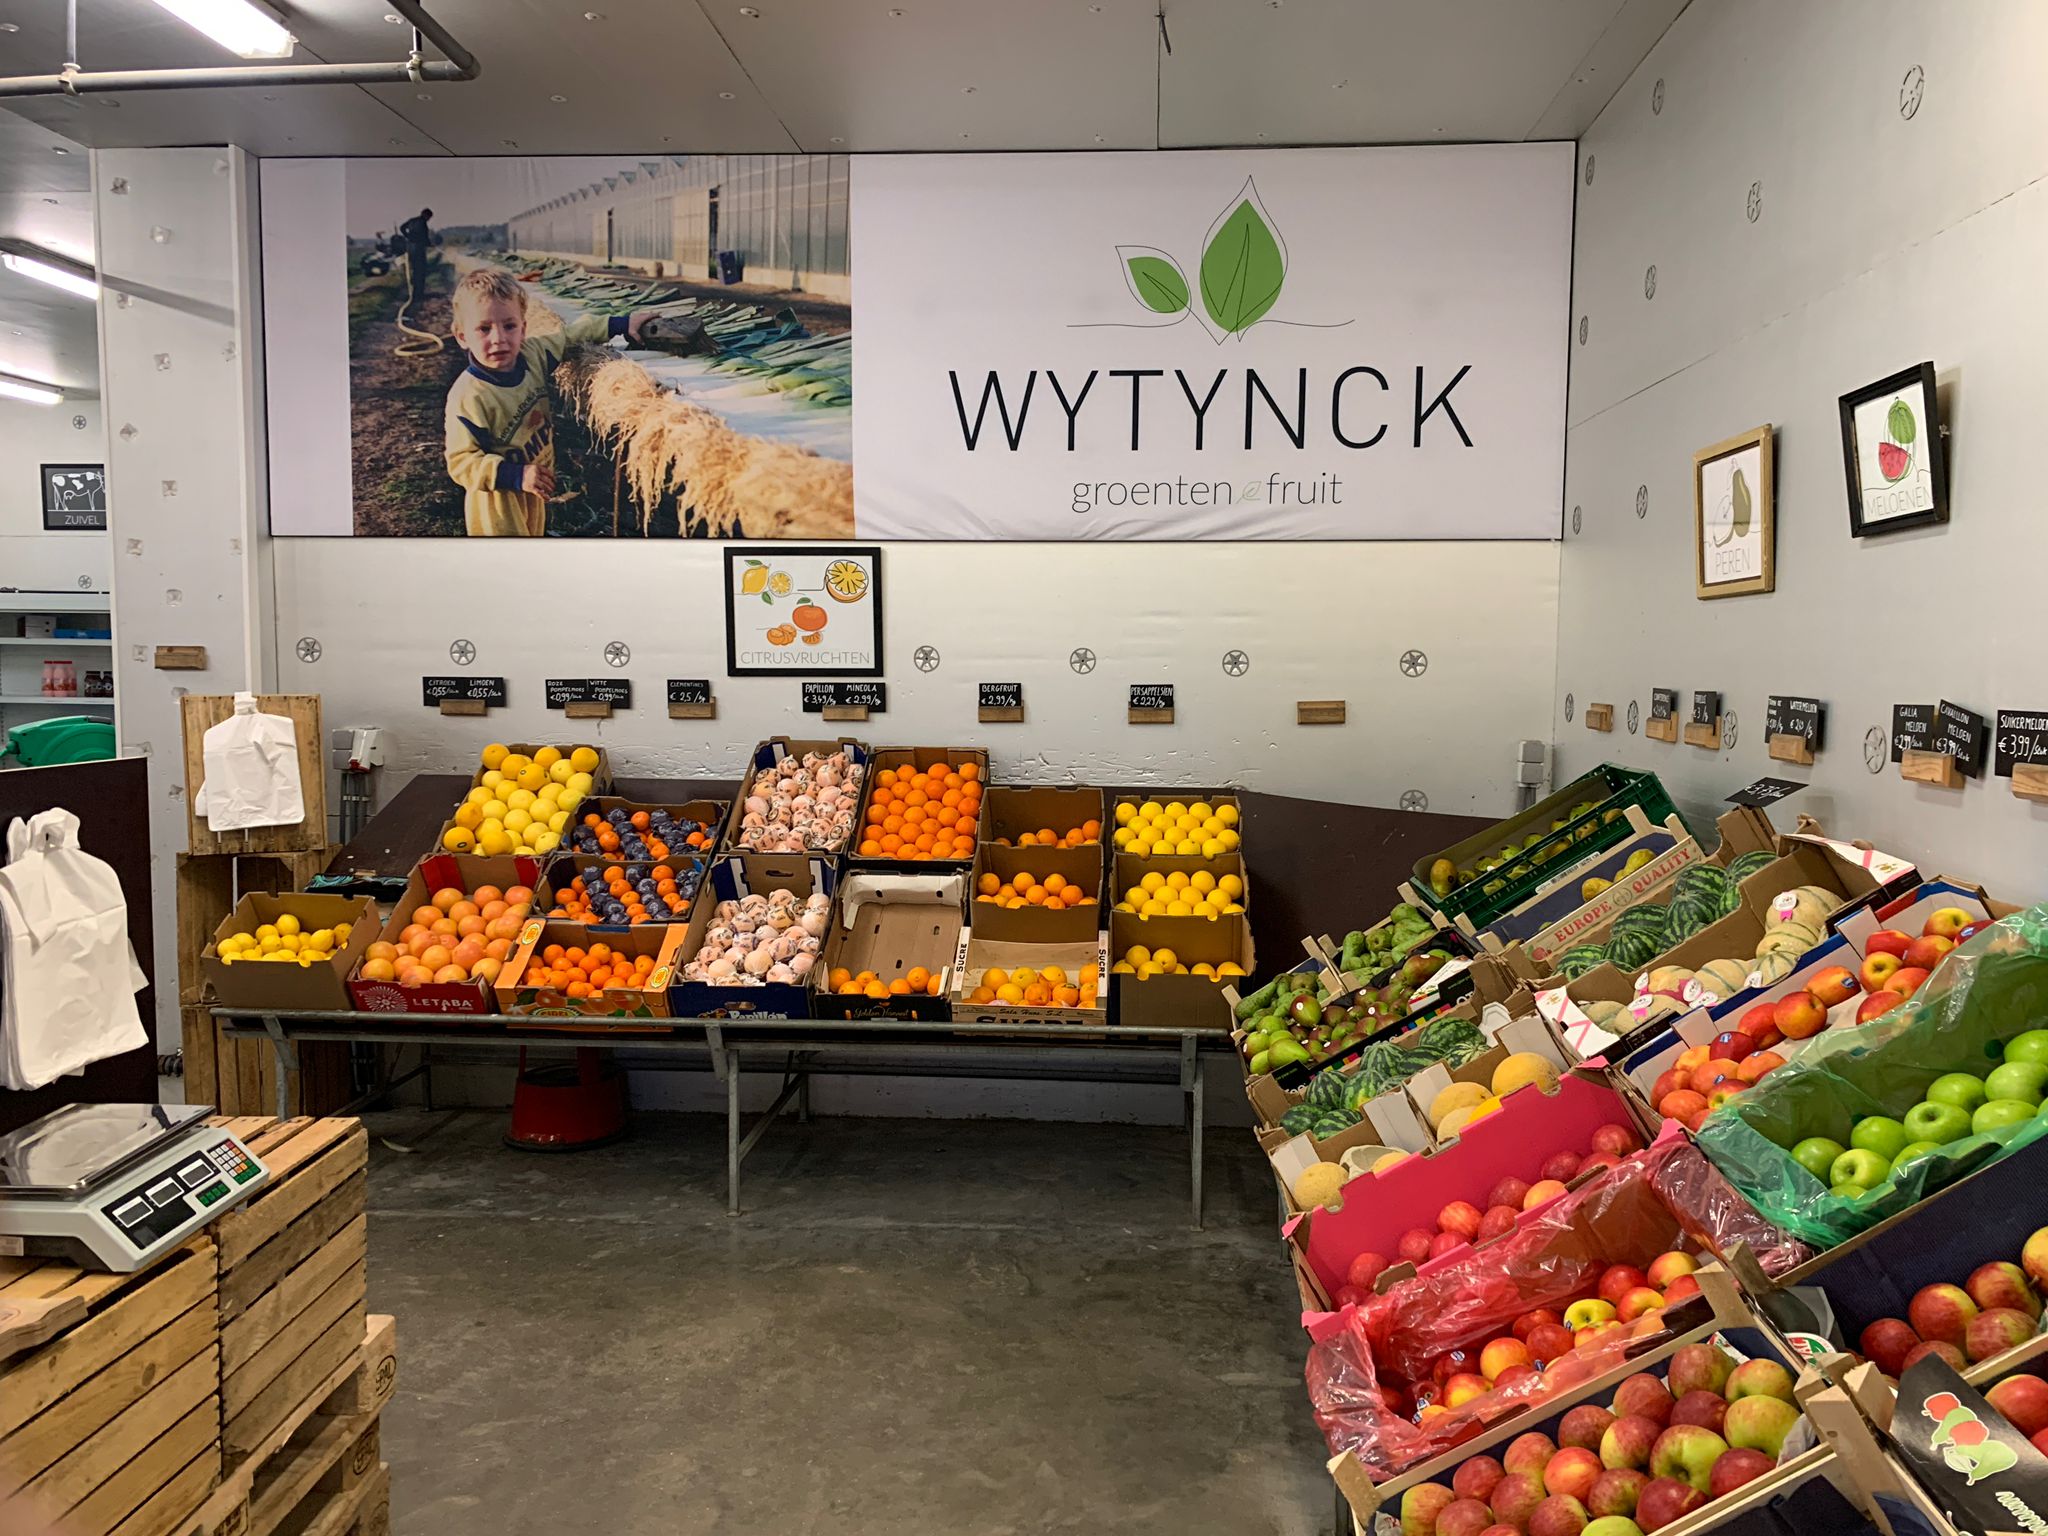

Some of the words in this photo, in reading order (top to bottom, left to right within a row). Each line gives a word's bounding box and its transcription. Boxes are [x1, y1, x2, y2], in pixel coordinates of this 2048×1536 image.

[948, 364, 1475, 452] WYTYNCK
[1072, 475, 1233, 514] groenten
[1266, 472, 1344, 505] fruit
[1867, 485, 1932, 517] MELOENEN
[64, 514, 101, 525] ZUIVEL
[1714, 548, 1750, 576] PEREN
[740, 651, 871, 665] CITRUSVRUCHTEN
[469, 679, 495, 687] LIMOEN
[805, 684, 834, 694] PAPILLON
[846, 683, 877, 692] MINEOLA
[981, 684, 1019, 693] BERGFRUIT
[1899, 706, 1918, 718] GALIA
[1905, 720, 1928, 733] MELOEN
[1947, 723, 1972, 744] MELOEN
[1554, 900, 1613, 943] EUROPE
[1631, 847, 1692, 894] QUALITY
[956, 943, 968, 972] SUCRE
[1098, 948, 1107, 979] SUCRE
[412, 998, 473, 1008] LETABA
